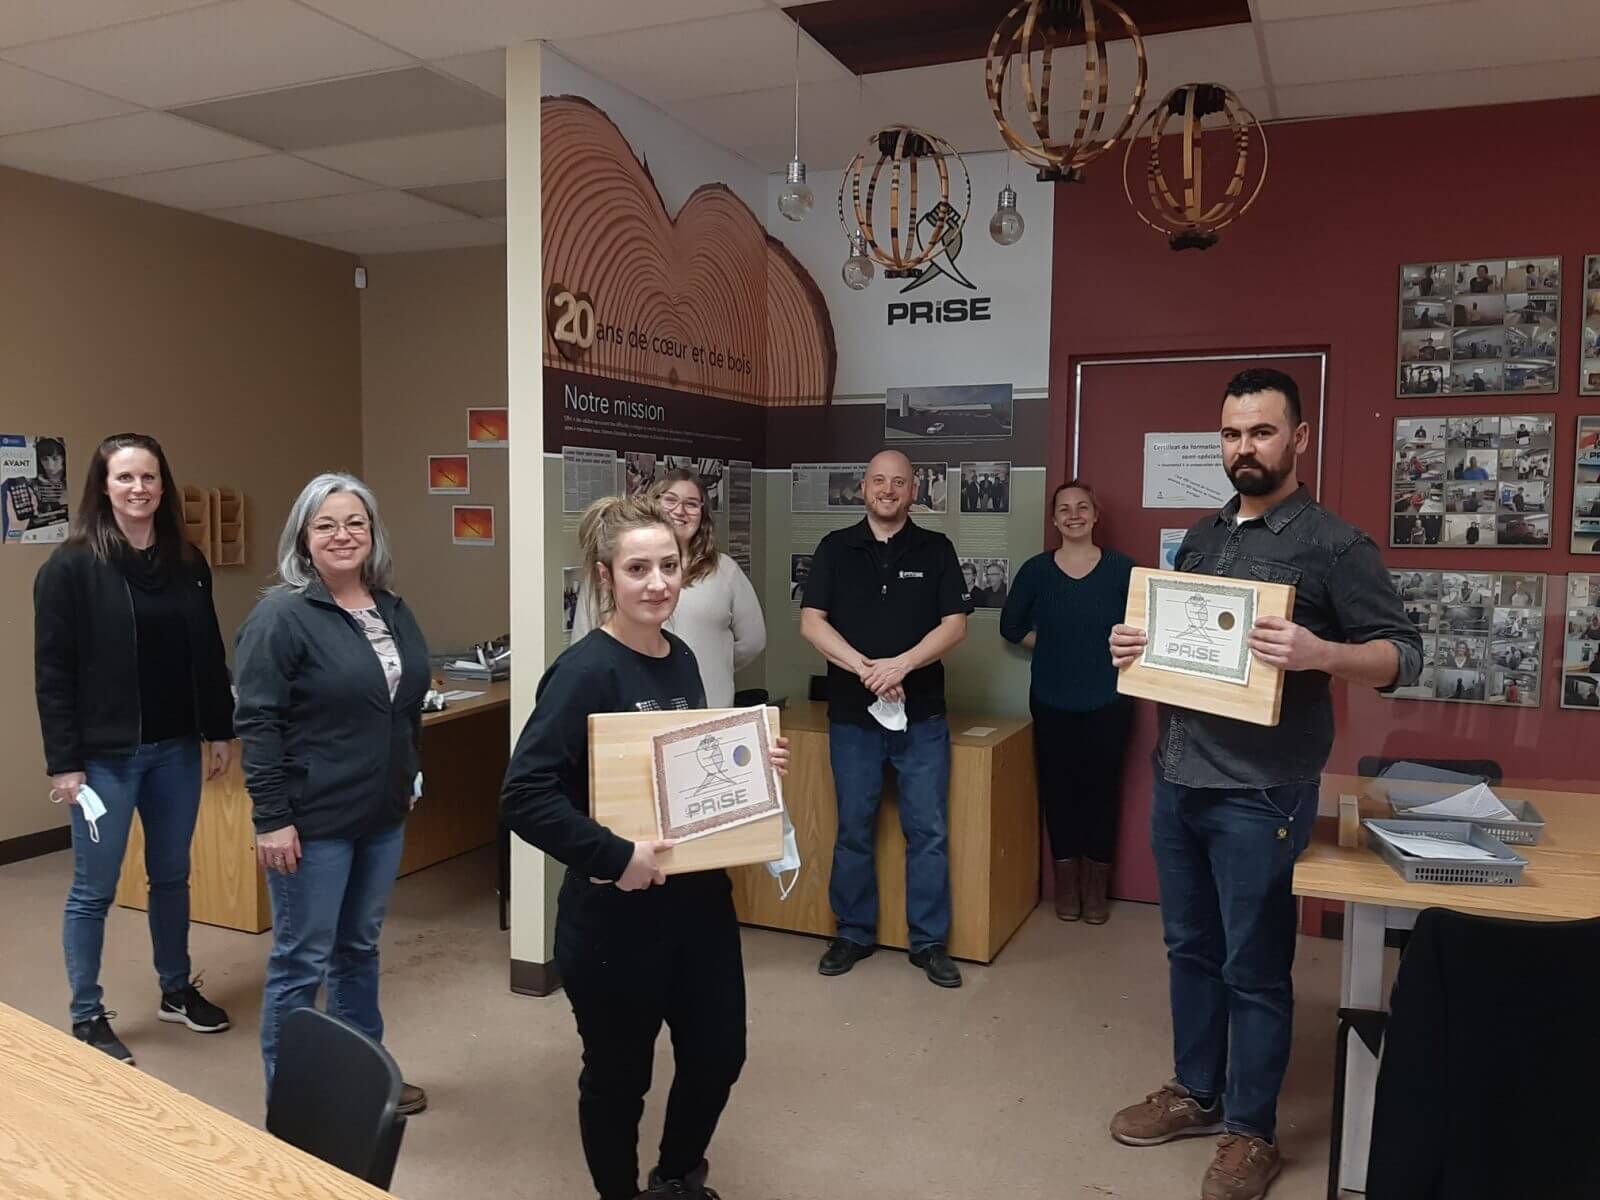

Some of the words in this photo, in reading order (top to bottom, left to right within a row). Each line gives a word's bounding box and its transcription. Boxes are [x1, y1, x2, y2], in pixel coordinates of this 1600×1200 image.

[553, 291, 595, 349] 20
[596, 322, 624, 345] ans
[628, 325, 648, 350] de
[652, 336, 687, 360] cœur
[691, 346, 705, 365] et
[708, 344, 724, 369] de
[727, 346, 752, 375] bois
[564, 384, 609, 414] Notre
[614, 395, 665, 421] mission
[3, 460, 30, 468] AVANT
